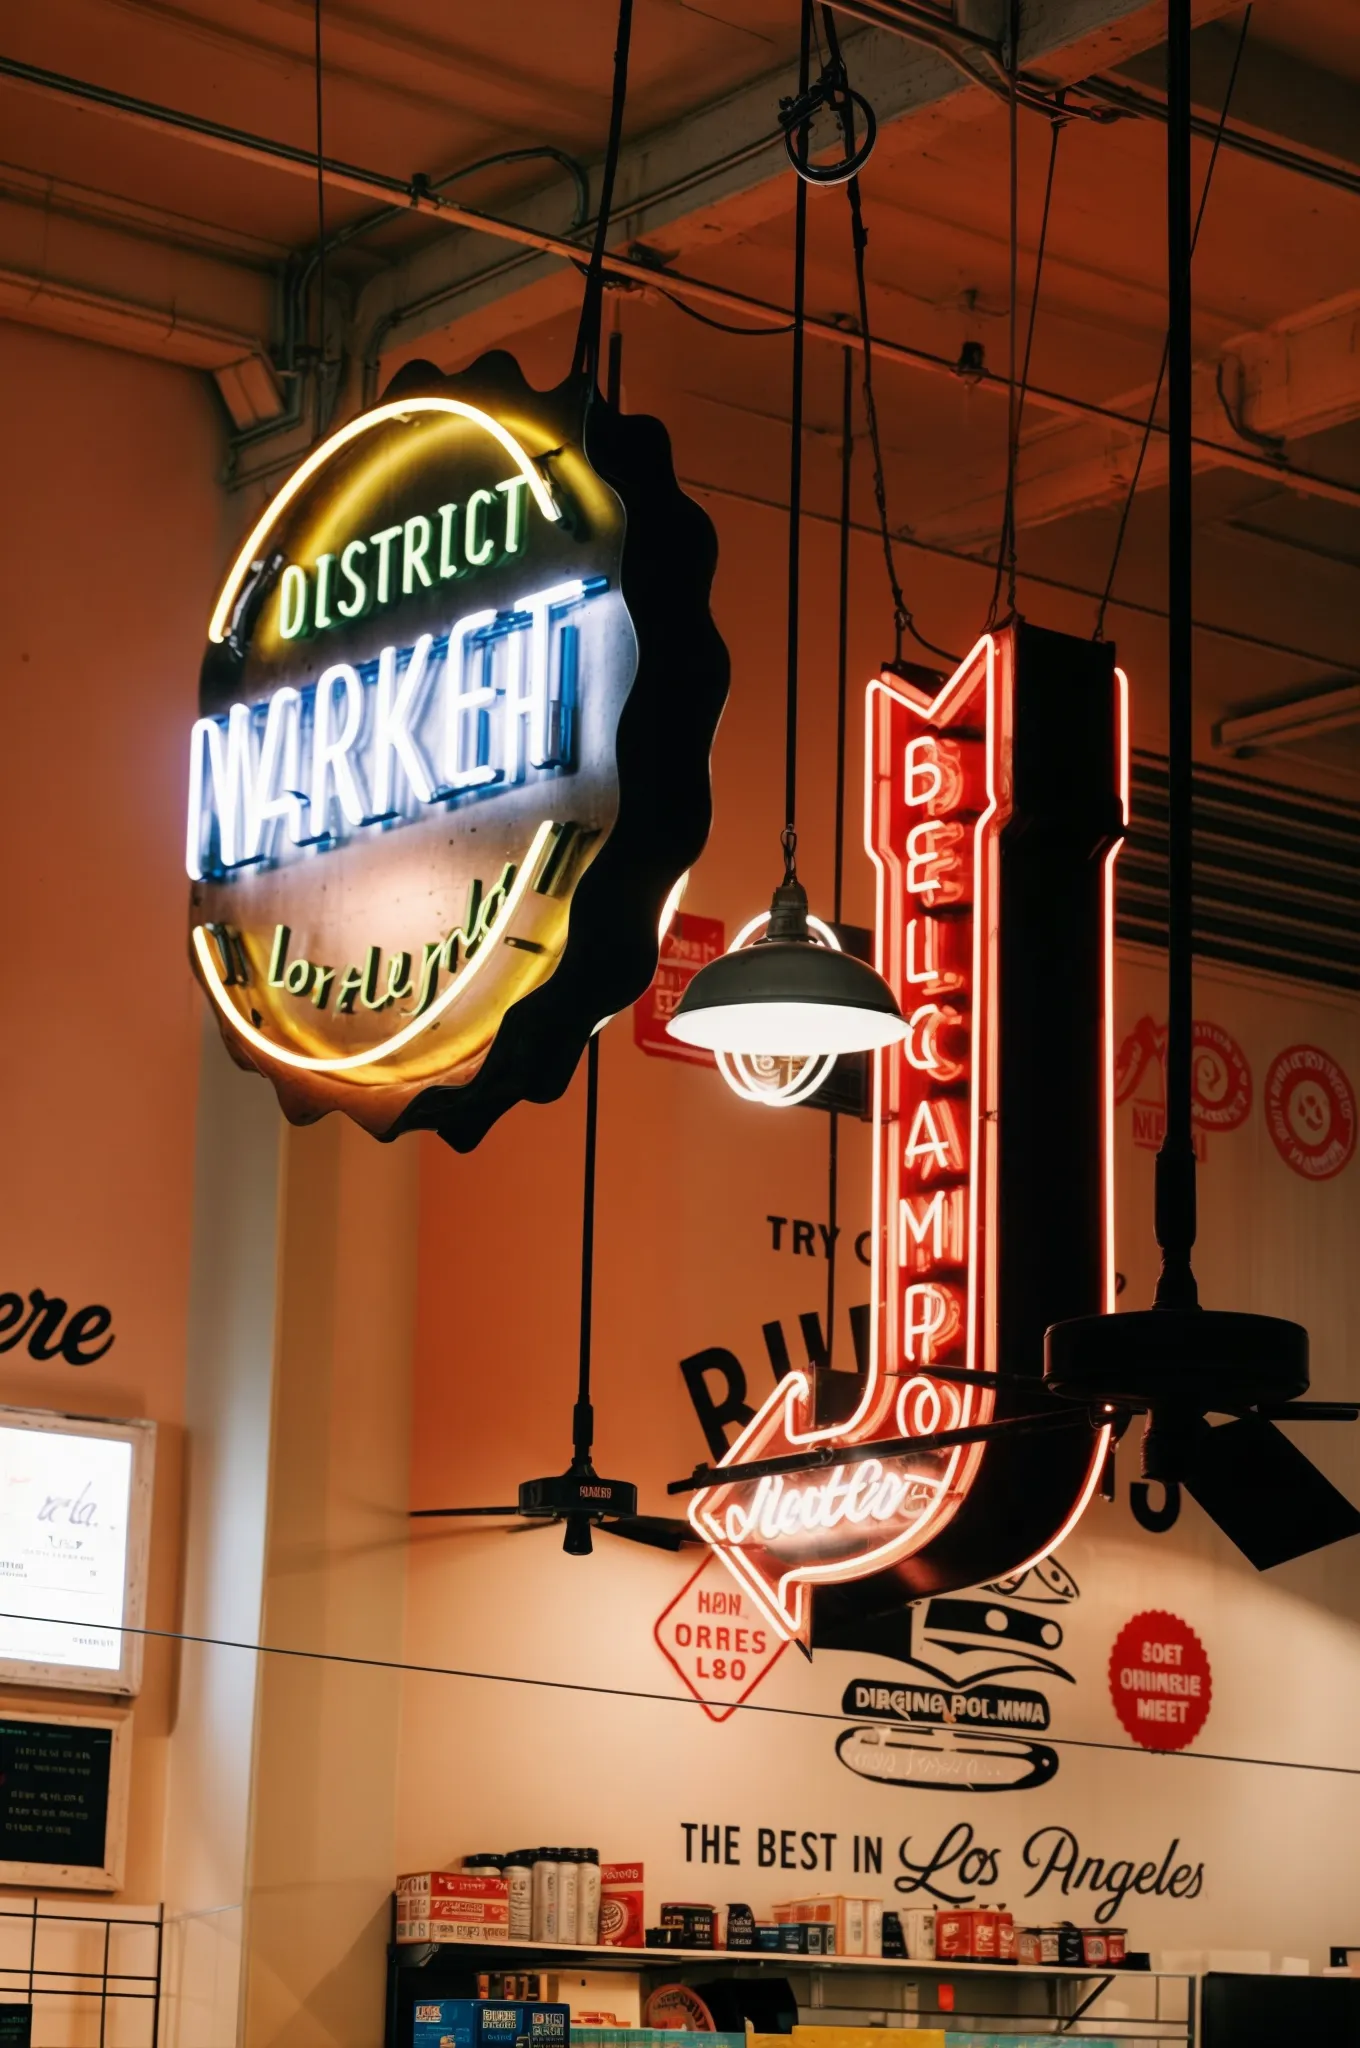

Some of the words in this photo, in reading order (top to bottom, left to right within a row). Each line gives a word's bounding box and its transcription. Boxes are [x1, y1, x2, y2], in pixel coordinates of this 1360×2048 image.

[279, 474, 530, 640] DISTRICT
[897, 733, 952, 1438] BELCAMPO
[766, 1214, 841, 1261] TRY
[675, 1623, 766, 1654] ORRES
[680, 1822, 741, 1866] THE
[756, 1827, 838, 1873] BEST
[853, 1833, 883, 1875] IN
[893, 1822, 1001, 1905] Los
[1021, 1825, 1206, 1925] Angeles
